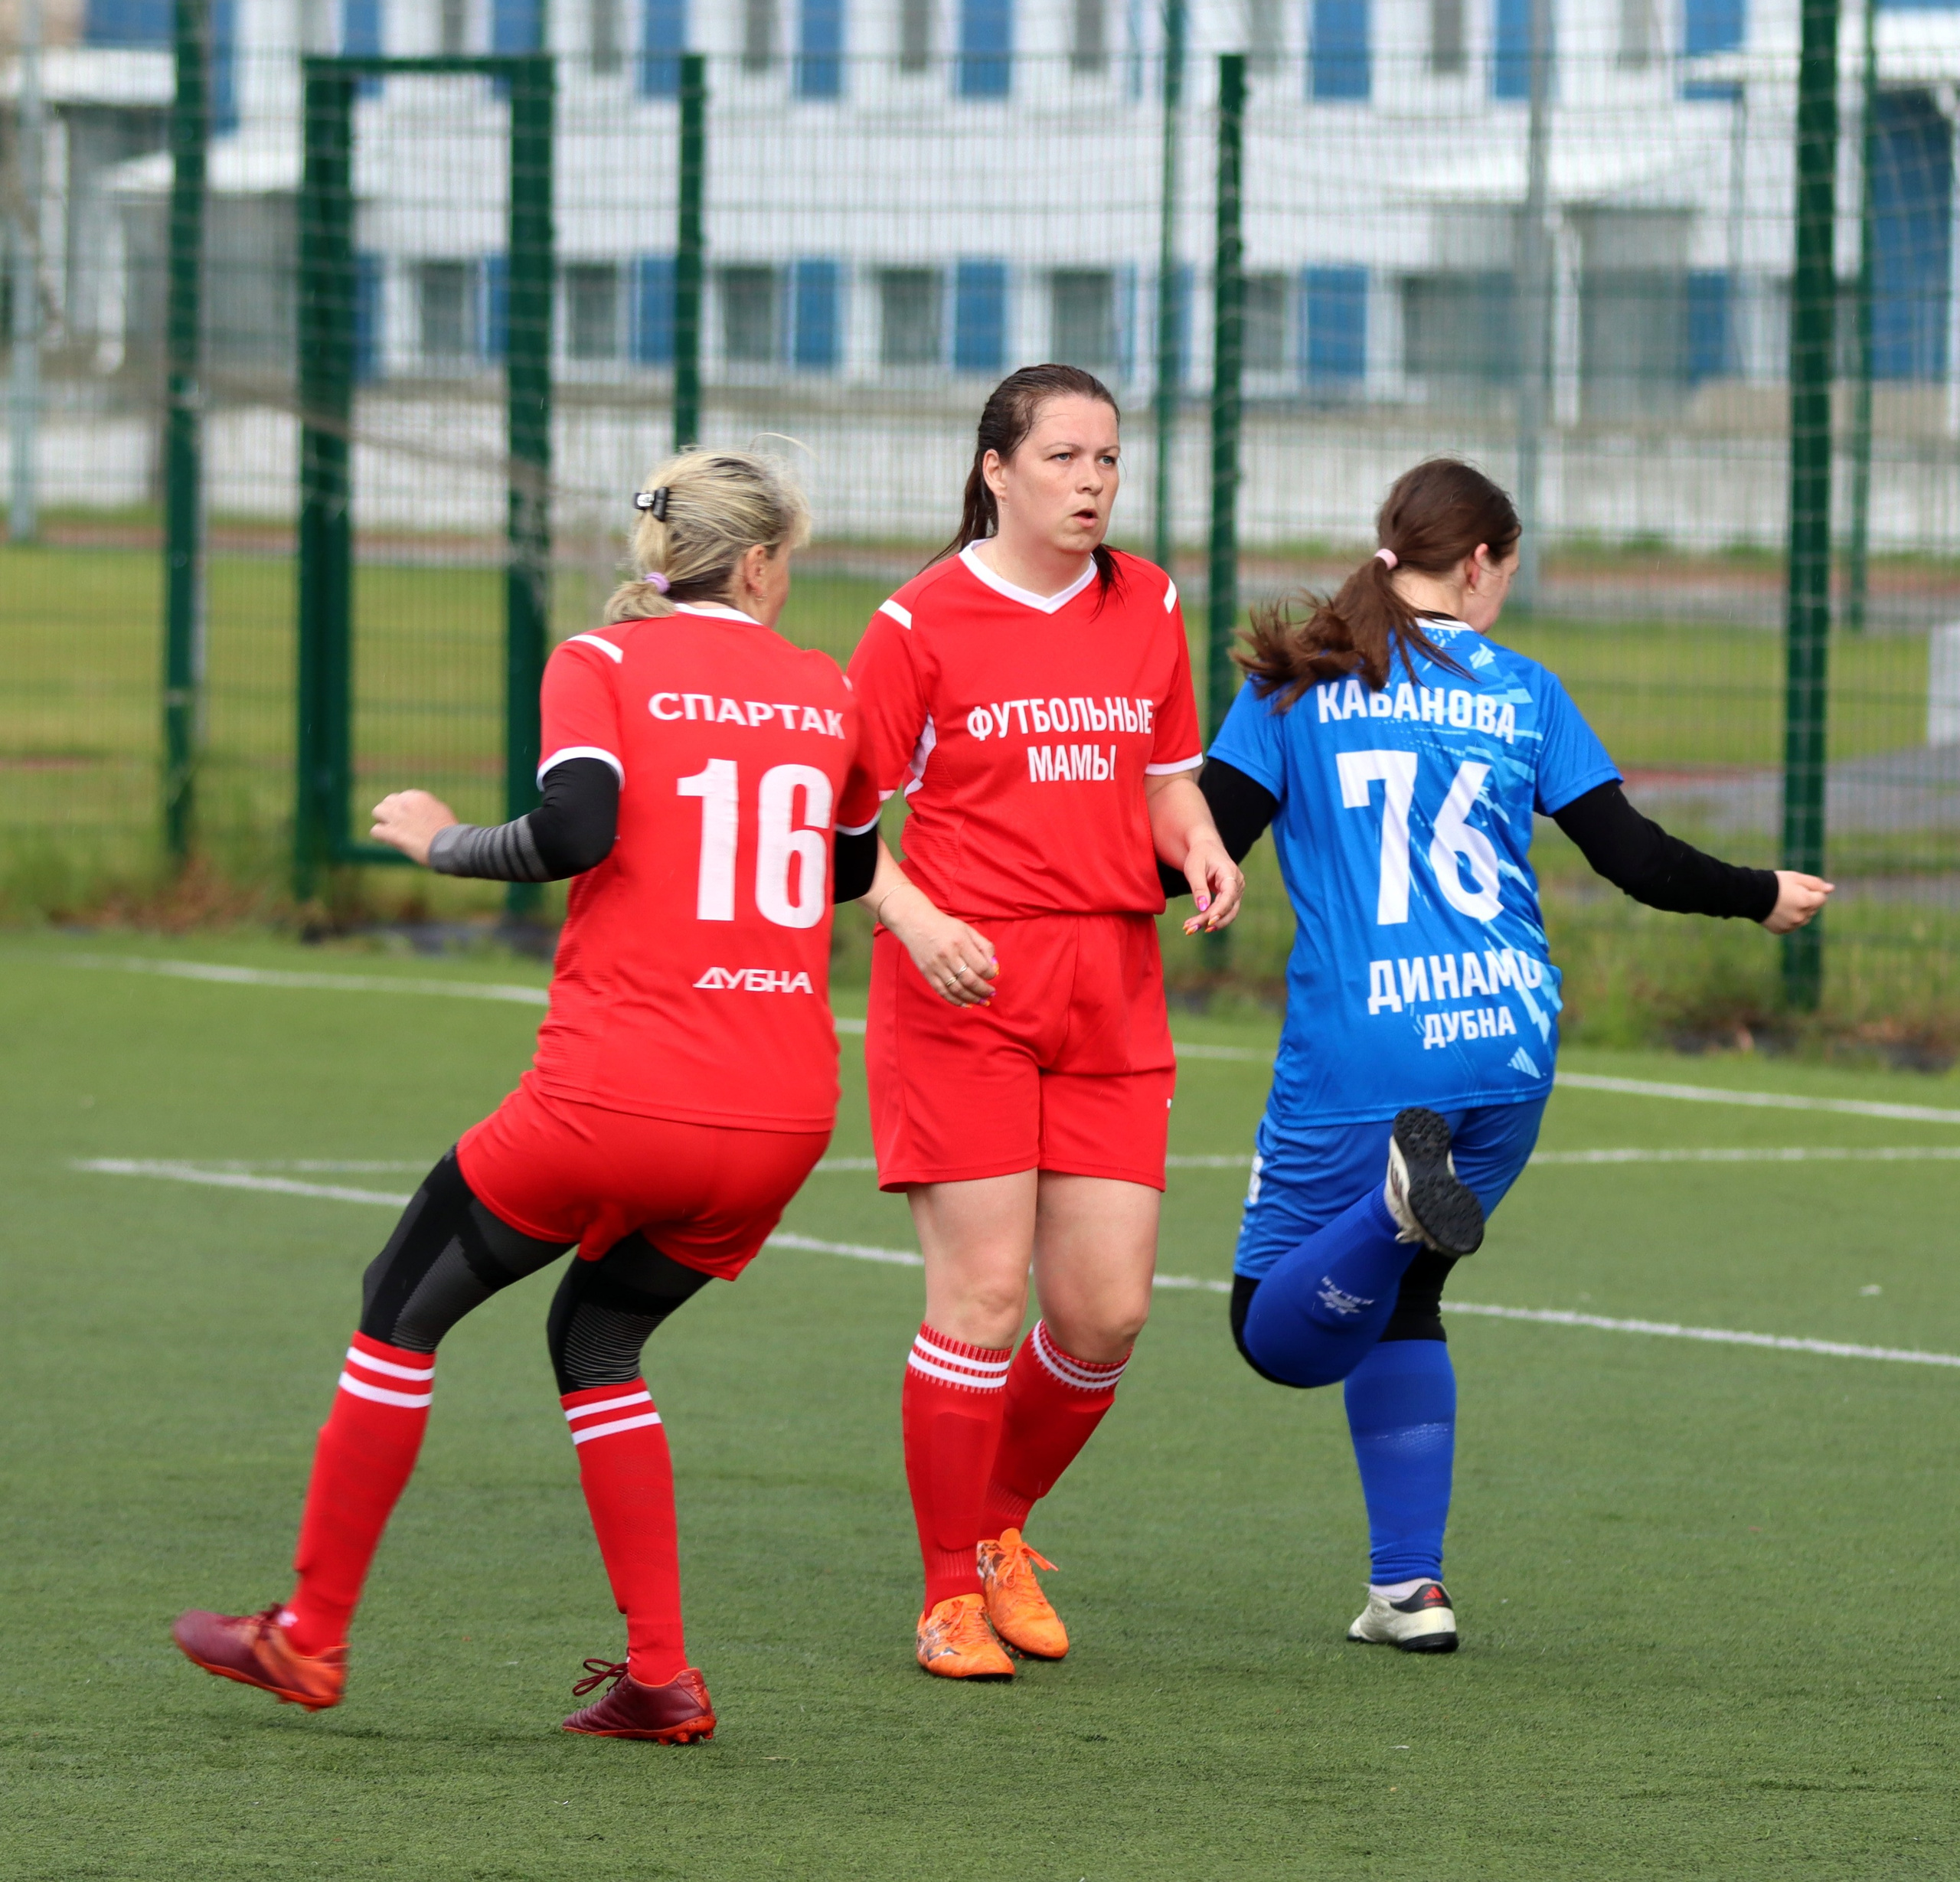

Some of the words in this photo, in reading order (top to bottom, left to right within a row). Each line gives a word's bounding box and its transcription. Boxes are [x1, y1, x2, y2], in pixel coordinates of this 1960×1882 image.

[648, 692, 845, 739] СПАРТАК
[966, 696, 1154, 741] ФУТБОЛЬНЫЕ
[1317, 679, 1516, 744] КАБАНОВА
[1027, 744, 1116, 783] МАМЫ
[677, 758, 833, 929] 16
[1336, 749, 1505, 925] 76
[693, 966, 813, 994] ДУБНА
[1367, 948, 1544, 1015] ДИНАМО
[1423, 1006, 1517, 1050] ДУБНА
